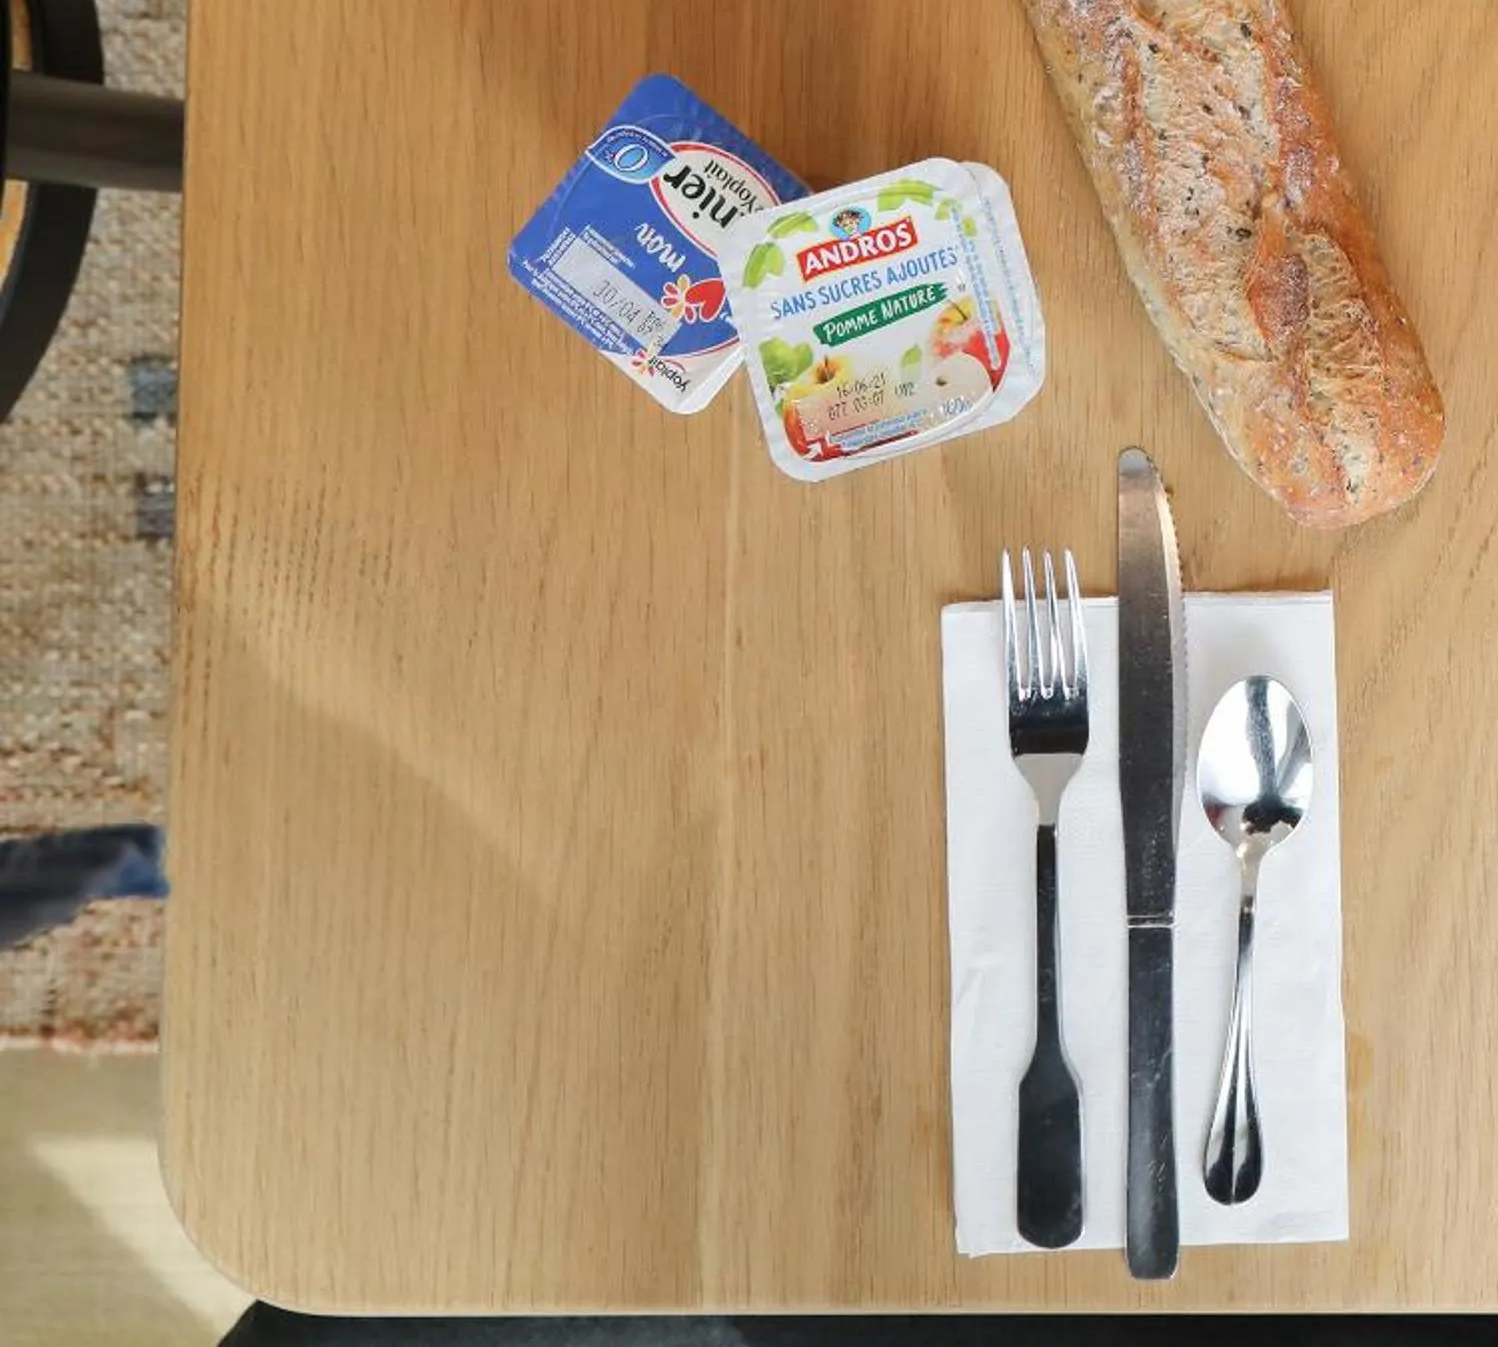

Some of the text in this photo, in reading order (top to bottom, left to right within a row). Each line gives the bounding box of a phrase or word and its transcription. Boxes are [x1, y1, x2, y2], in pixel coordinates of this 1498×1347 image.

[663, 165, 742, 229] nier
[703, 159, 760, 214] Yoplait
[634, 222, 687, 274] mon
[804, 222, 912, 276] ANDROS
[770, 289, 817, 321] SANS
[814, 270, 883, 305] SUCRES
[821, 284, 937, 341] POMME NATURE
[647, 355, 692, 393] Yoplait
